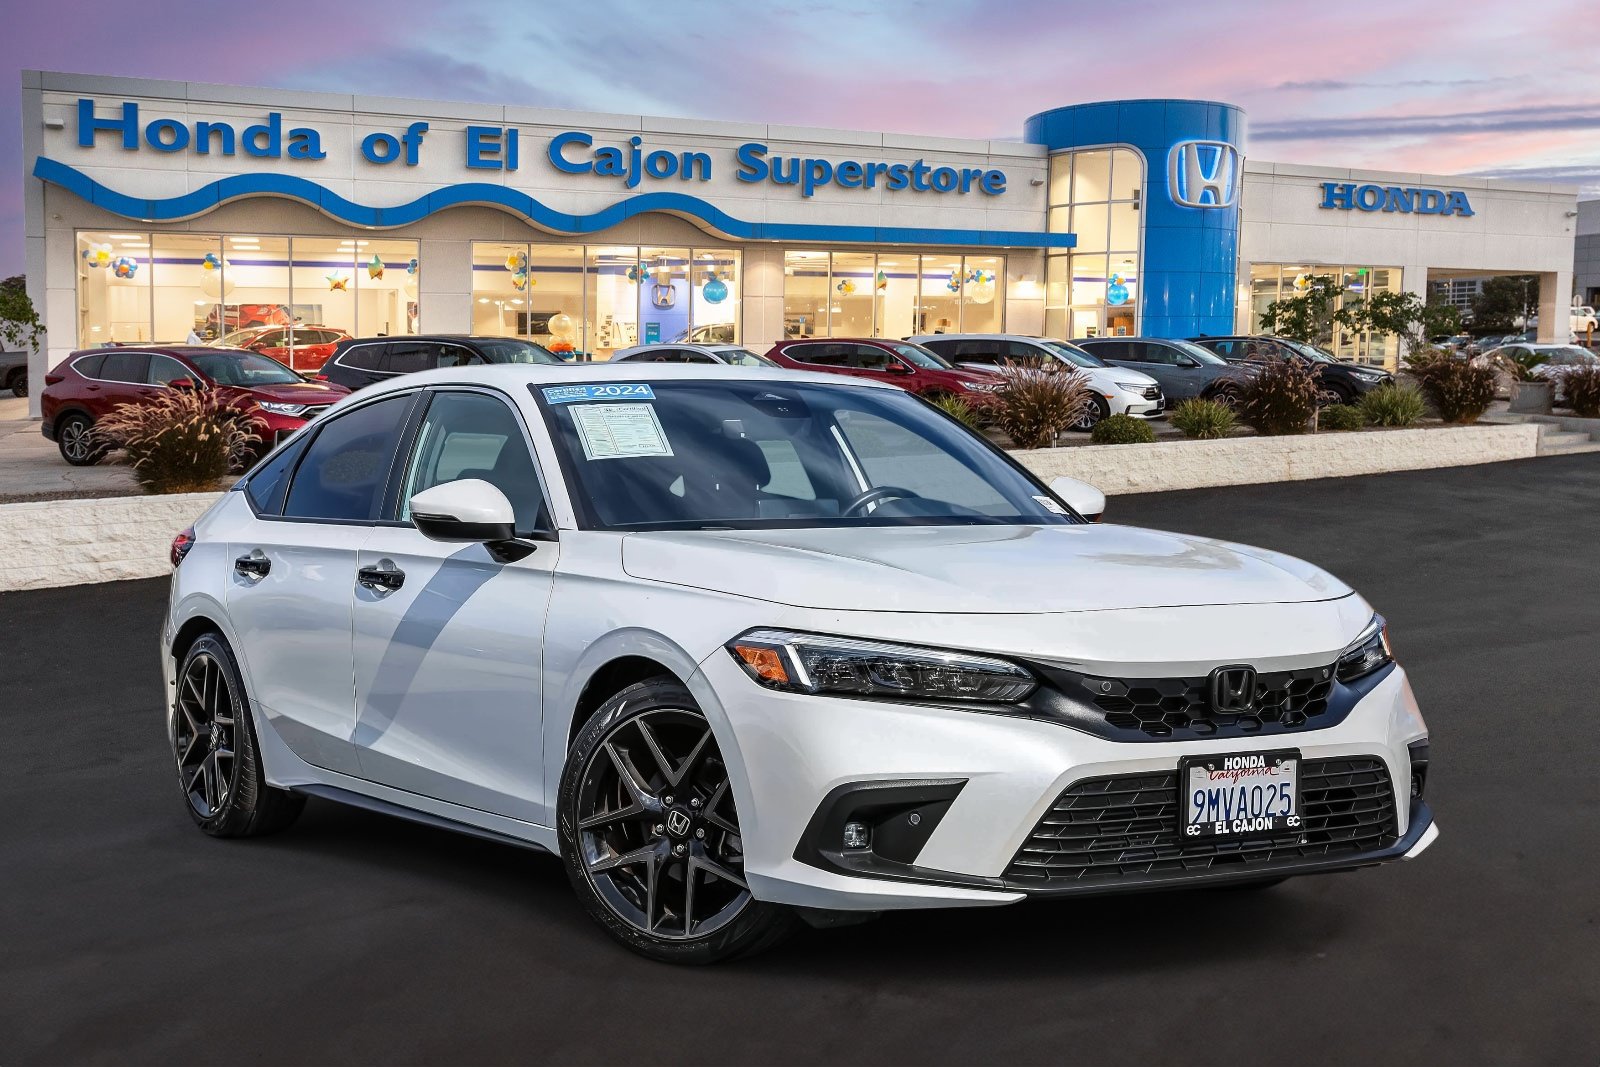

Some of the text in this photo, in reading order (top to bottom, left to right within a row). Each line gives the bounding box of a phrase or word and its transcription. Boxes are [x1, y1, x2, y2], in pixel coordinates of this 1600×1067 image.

[77, 98, 1008, 198] Honda of El Cajon Superstore
[1319, 182, 1476, 217] HONDA
[591, 385, 650, 396] 2024
[1224, 755, 1266, 771] HONDA
[1193, 782, 1293, 824] 9MVA025
[1215, 816, 1273, 835] EL CAJON
